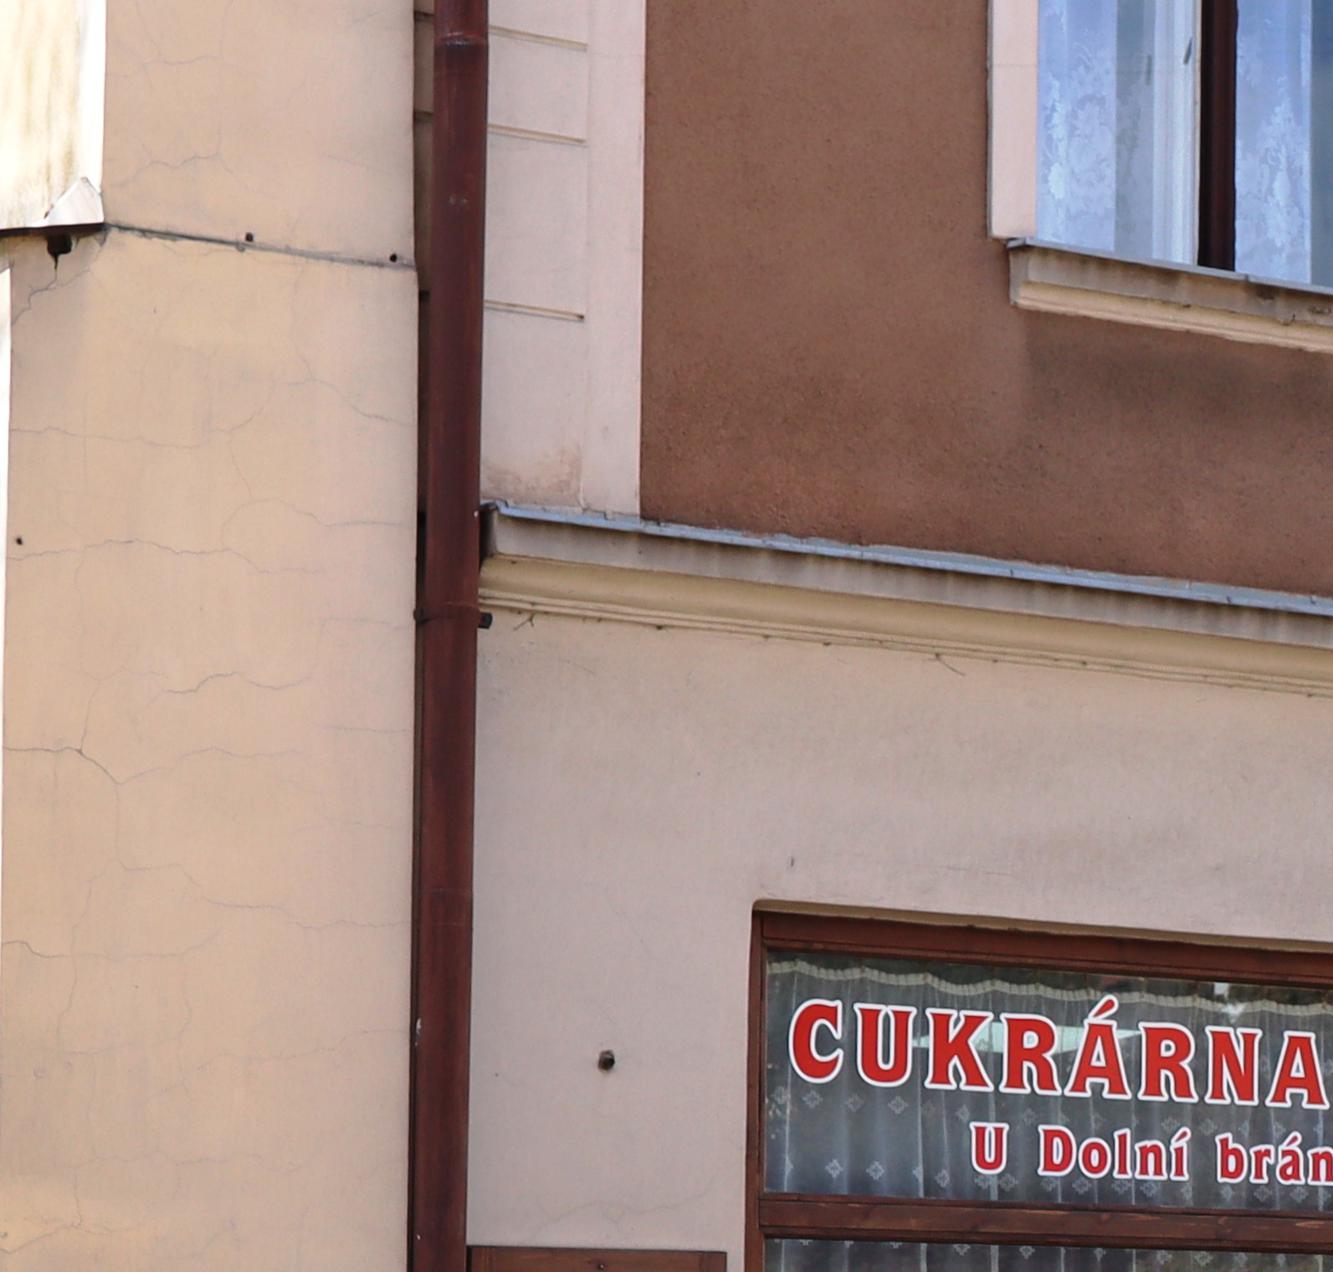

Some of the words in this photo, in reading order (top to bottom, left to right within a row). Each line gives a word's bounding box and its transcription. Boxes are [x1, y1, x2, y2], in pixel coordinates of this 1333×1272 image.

[789, 996, 1329, 1109] CUKRÁRNA
[969, 1122, 1009, 1175] U
[1037, 1124, 1191, 1181] Dolní
